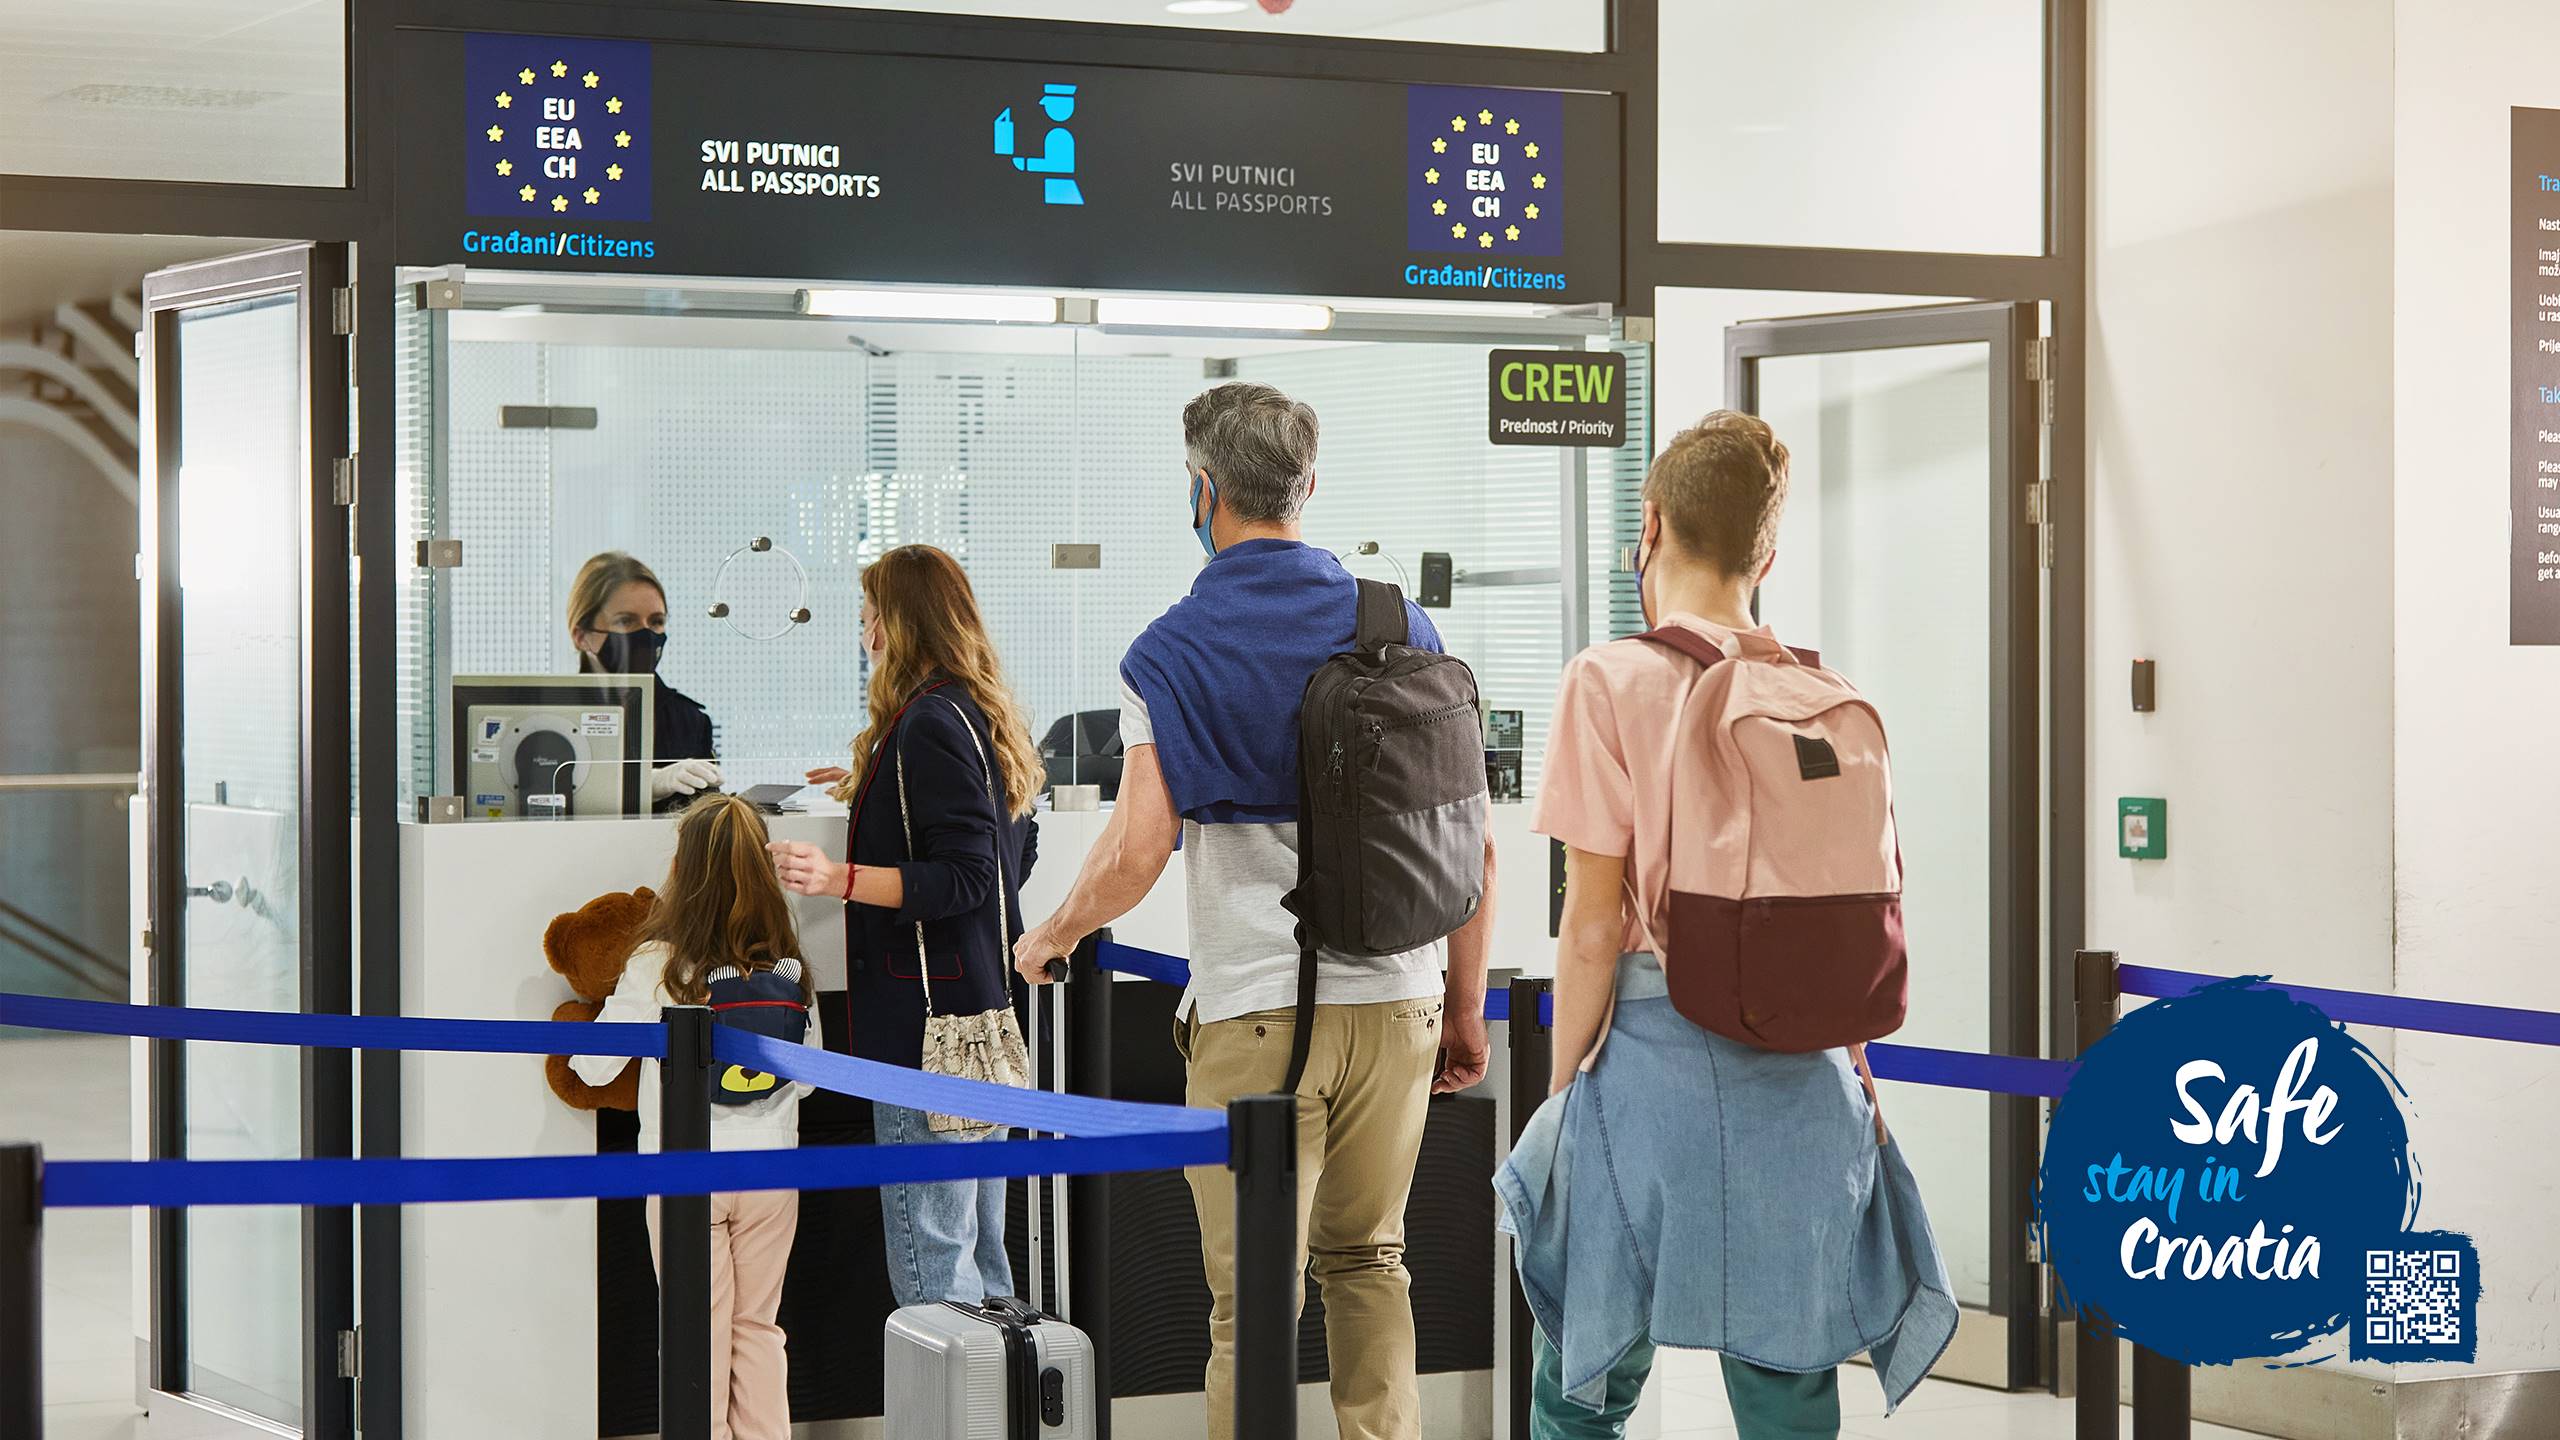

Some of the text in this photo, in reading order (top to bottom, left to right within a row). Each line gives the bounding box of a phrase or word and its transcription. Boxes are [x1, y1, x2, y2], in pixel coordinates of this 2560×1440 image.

[543, 97, 576, 121] EU
[536, 126, 583, 151] EEA
[701, 139, 840, 168] SVI PUTNICI
[1472, 142, 1500, 165] EU
[543, 155, 576, 179] CH
[1170, 162, 1295, 187] SVI PUTNICI
[701, 169, 881, 198] ALL PASSPORTS
[1465, 169, 1506, 192] EEA
[1170, 190, 1333, 217] ALL PASSPORTS
[1471, 195, 1500, 218] CH
[2538, 263, 2560, 277] mož
[2538, 310, 2546, 321] u
[1499, 361, 1615, 404] CREW
[1499, 418, 1558, 434] Prednost
[1568, 420, 1615, 438] Priority
[2538, 477, 2559, 491] may
[2537, 522, 2560, 537] rang
[2537, 567, 2553, 582] get
